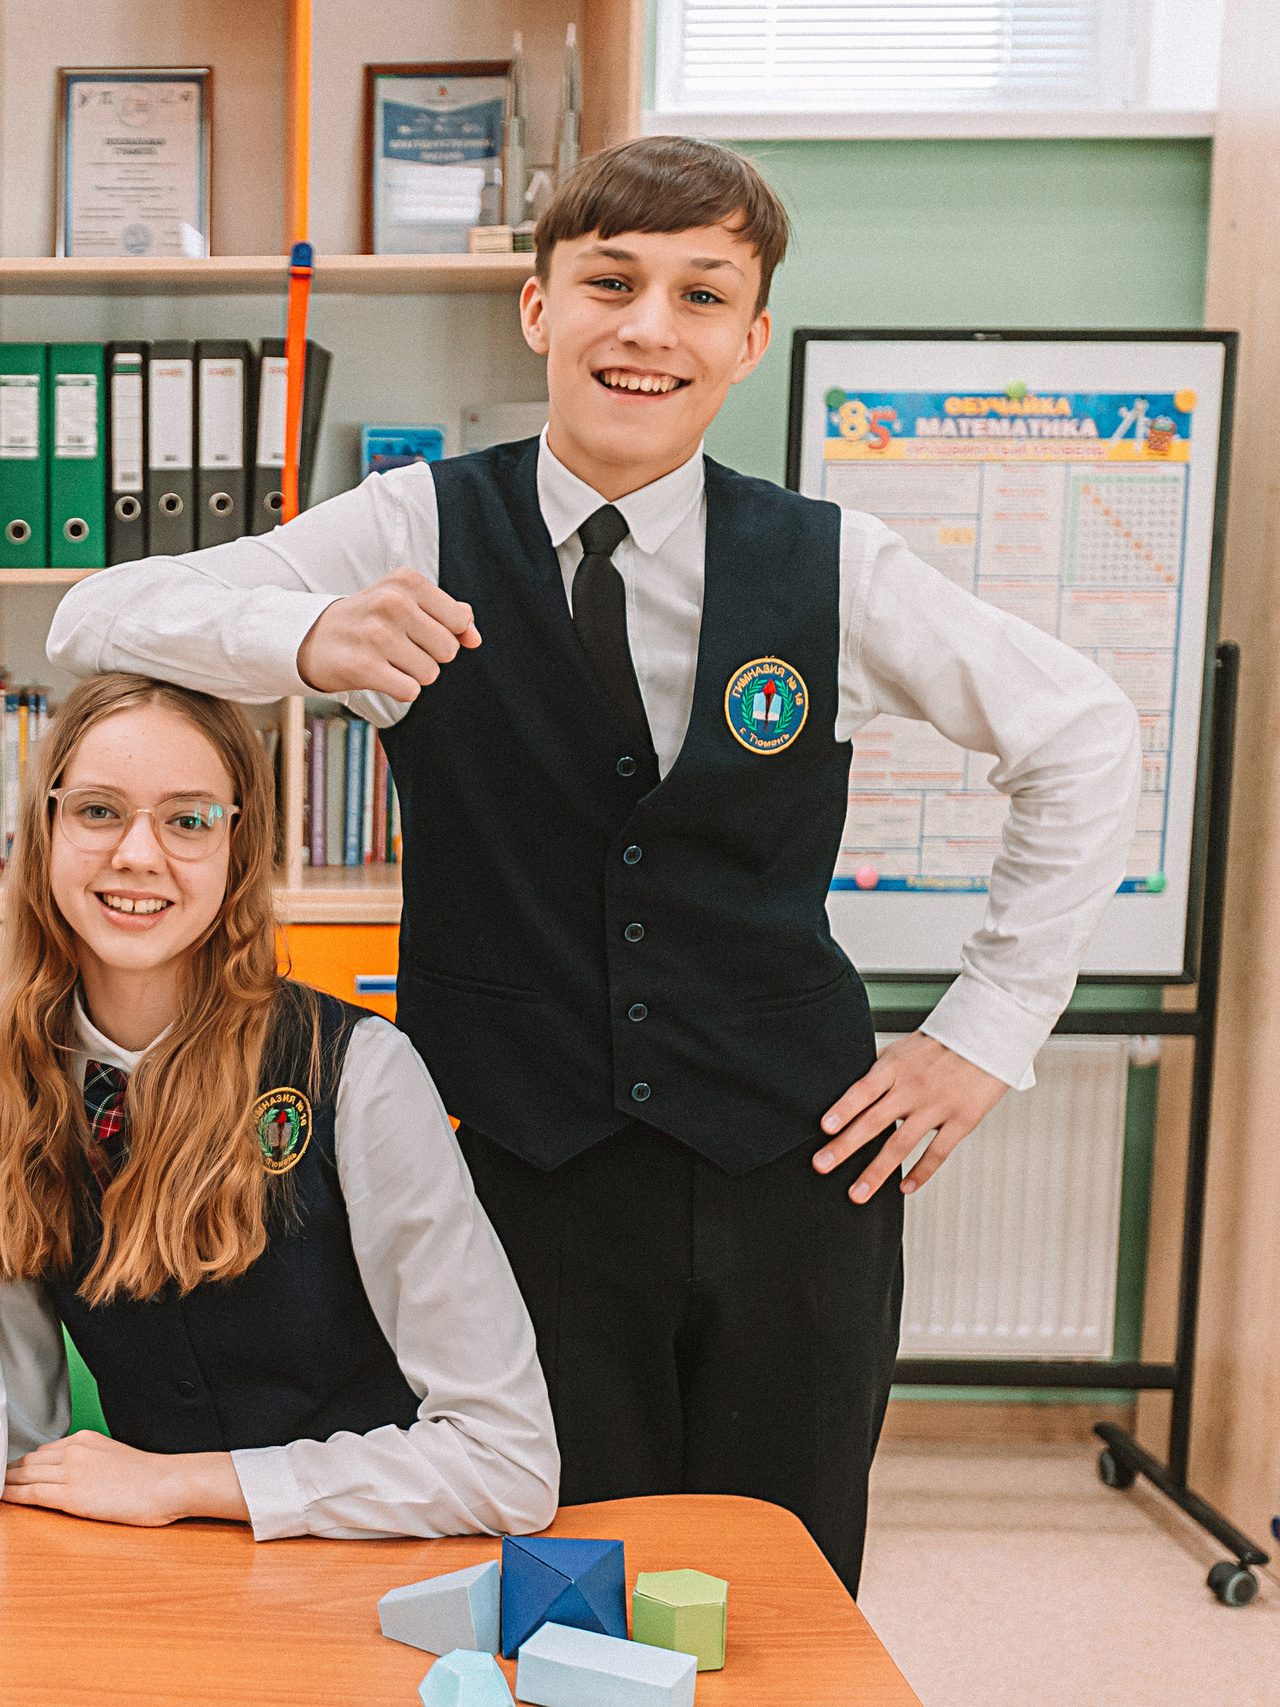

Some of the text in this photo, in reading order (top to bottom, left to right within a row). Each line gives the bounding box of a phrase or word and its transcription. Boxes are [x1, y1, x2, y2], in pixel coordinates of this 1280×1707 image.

[944, 395, 1071, 415] ОБУЧАЙКА
[915, 417, 1100, 438] МАТЕМАТИКА
[732, 664, 804, 706] ГИМНАЗИЯ № 16
[750, 734, 790, 748] Тюмень
[253, 1094, 296, 1124] МНАЗИЯ
